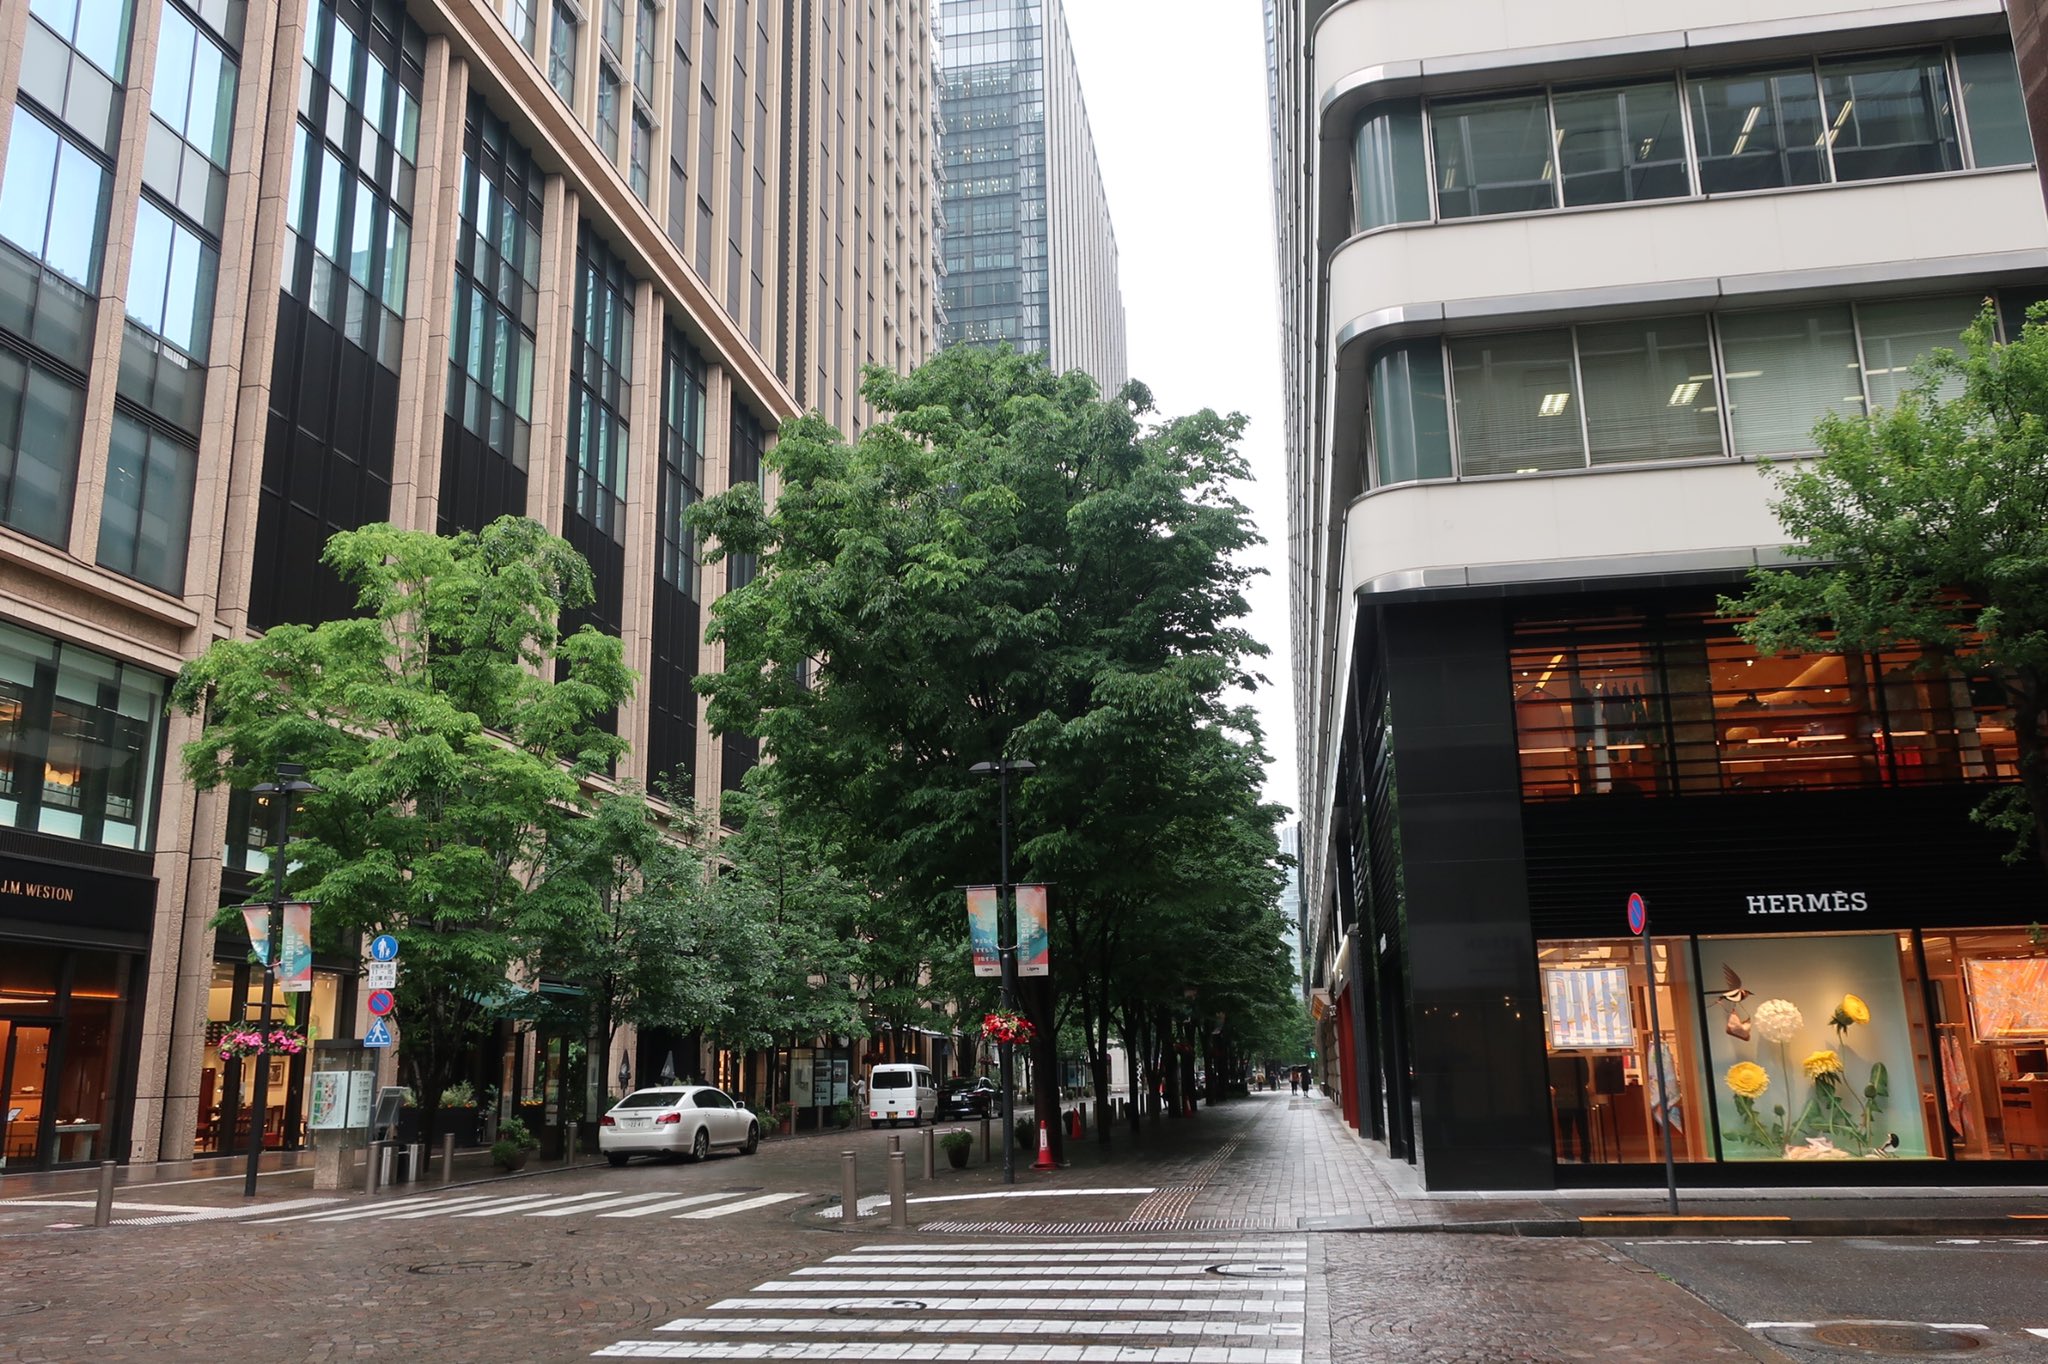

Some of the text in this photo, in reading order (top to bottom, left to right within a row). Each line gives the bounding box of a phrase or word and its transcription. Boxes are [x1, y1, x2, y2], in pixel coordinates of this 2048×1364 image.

[1, 880, 73, 902] J.M. WESTON
[1745, 890, 1868, 914] HERMÈS
[1021, 918, 1030, 961] TOGETHER
